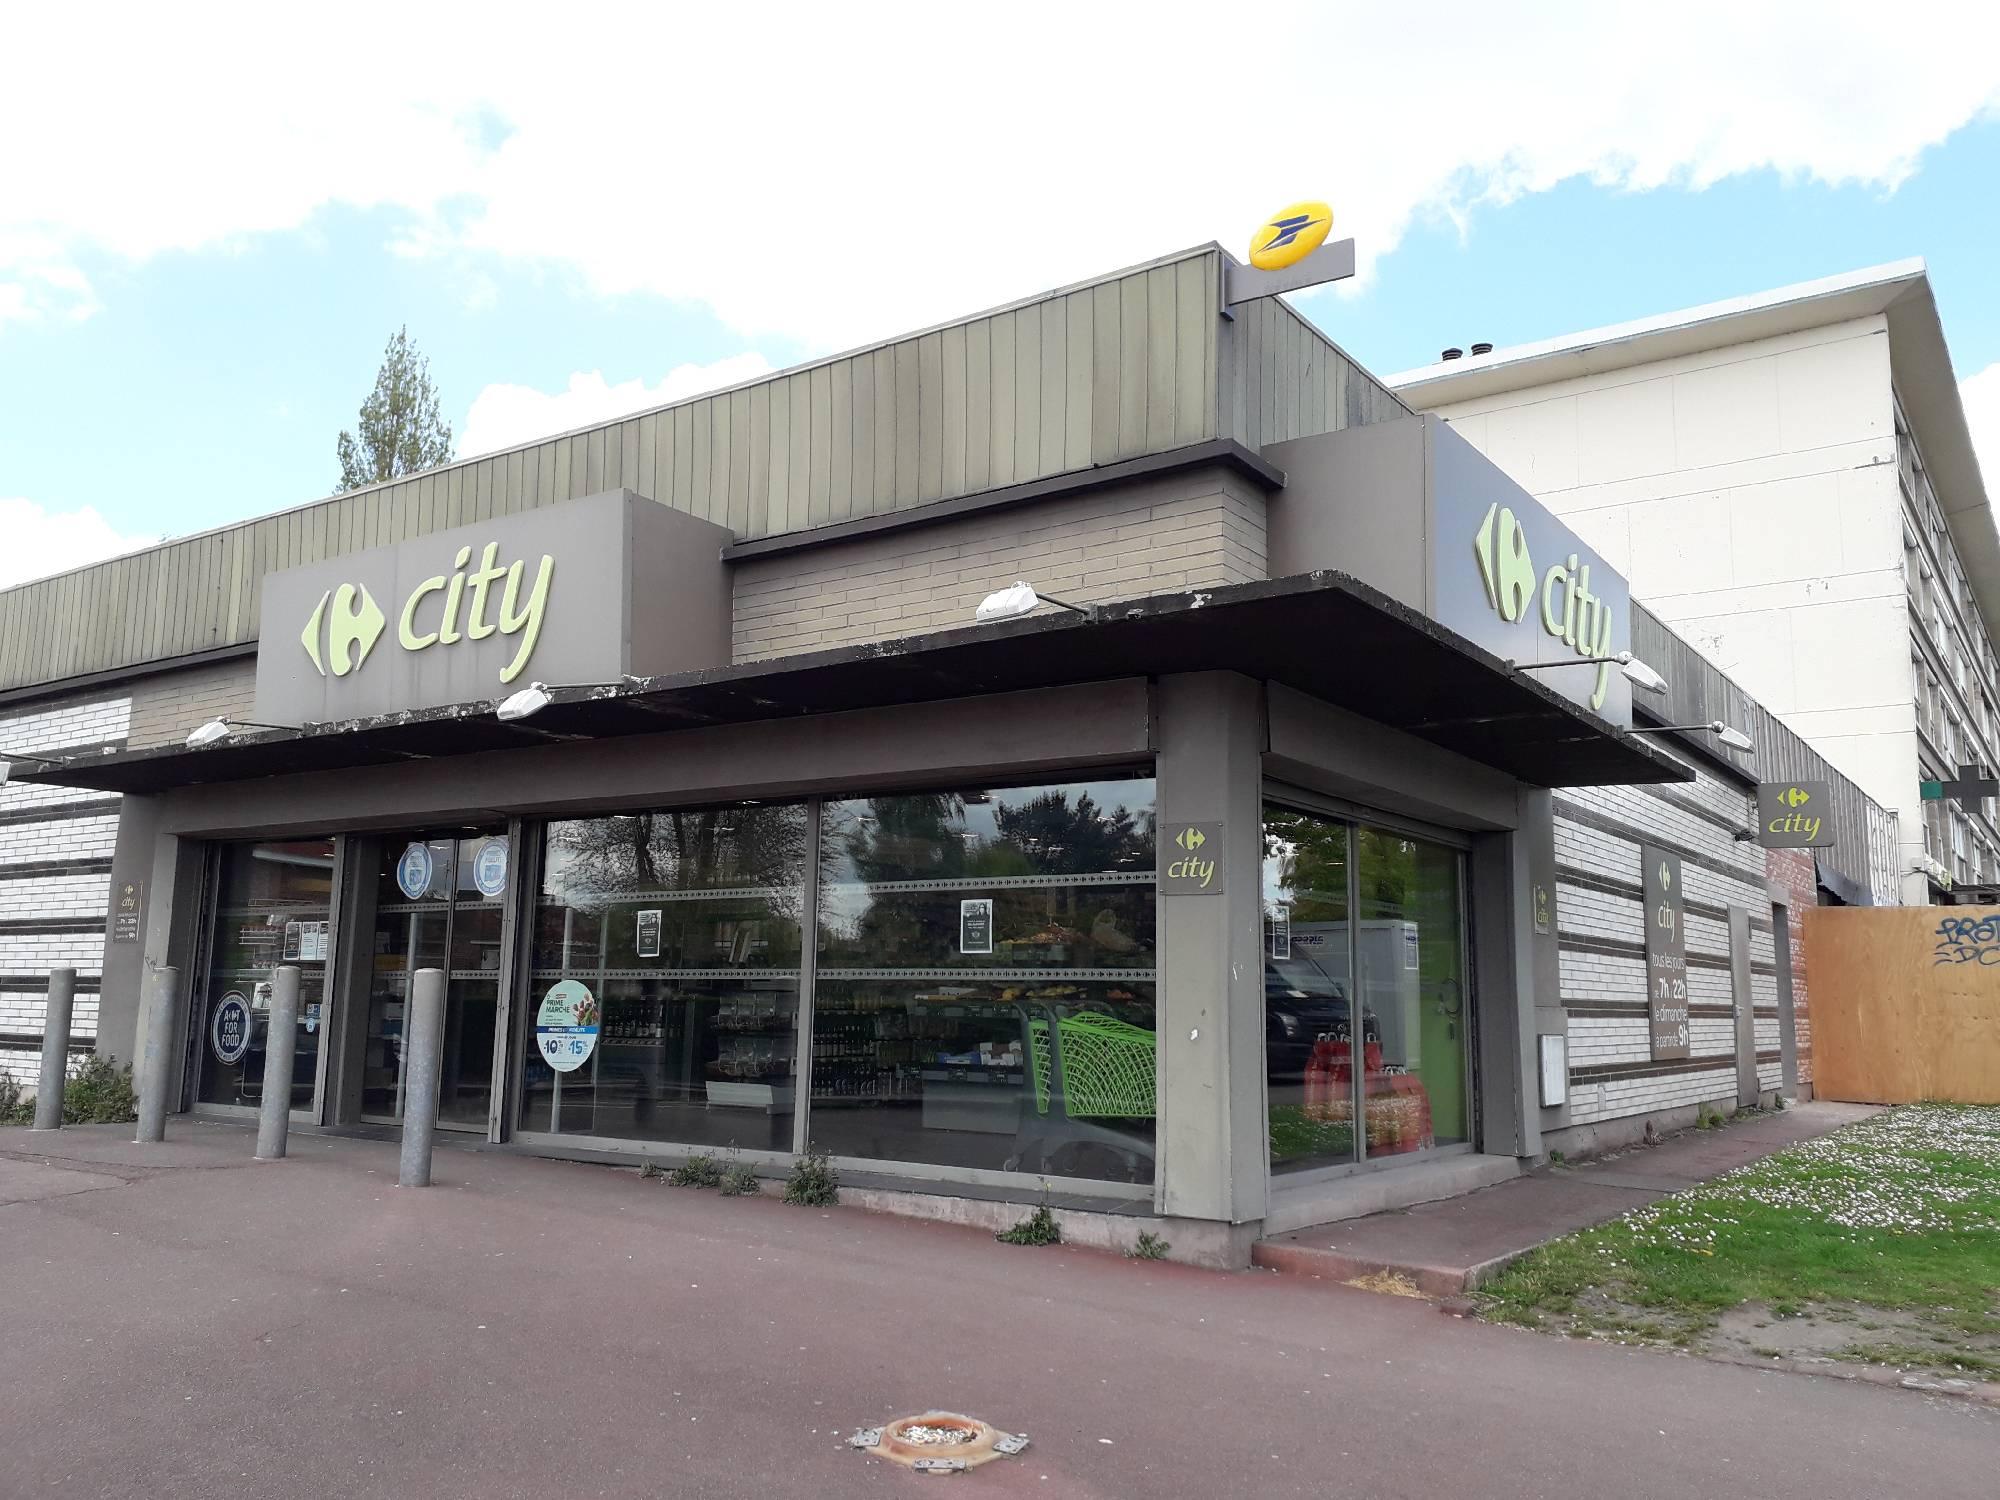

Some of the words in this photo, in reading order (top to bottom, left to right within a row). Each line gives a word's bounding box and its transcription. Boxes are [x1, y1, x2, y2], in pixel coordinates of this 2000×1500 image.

[398, 541, 555, 683] city
[1542, 554, 1612, 710] city
[1769, 813, 1821, 841] city
[1168, 856, 1215, 888] city
[121, 897, 135, 910] city
[1658, 900, 1675, 943] city
[1652, 952, 1664, 968] tous
[1664, 953, 1672, 969] les
[1672, 954, 1685, 973] jours
[1659, 977, 1669, 998] 7h
[1672, 978, 1687, 1000] 22h
[545, 1005, 571, 1014] MARCHÉ
[1655, 1005, 1661, 1022] le
[1660, 1004, 1687, 1023] dimanche
[224, 1022, 238, 1034] FOR
[1678, 1023, 1689, 1047] 9h
[221, 1034, 240, 1047] FOOD
